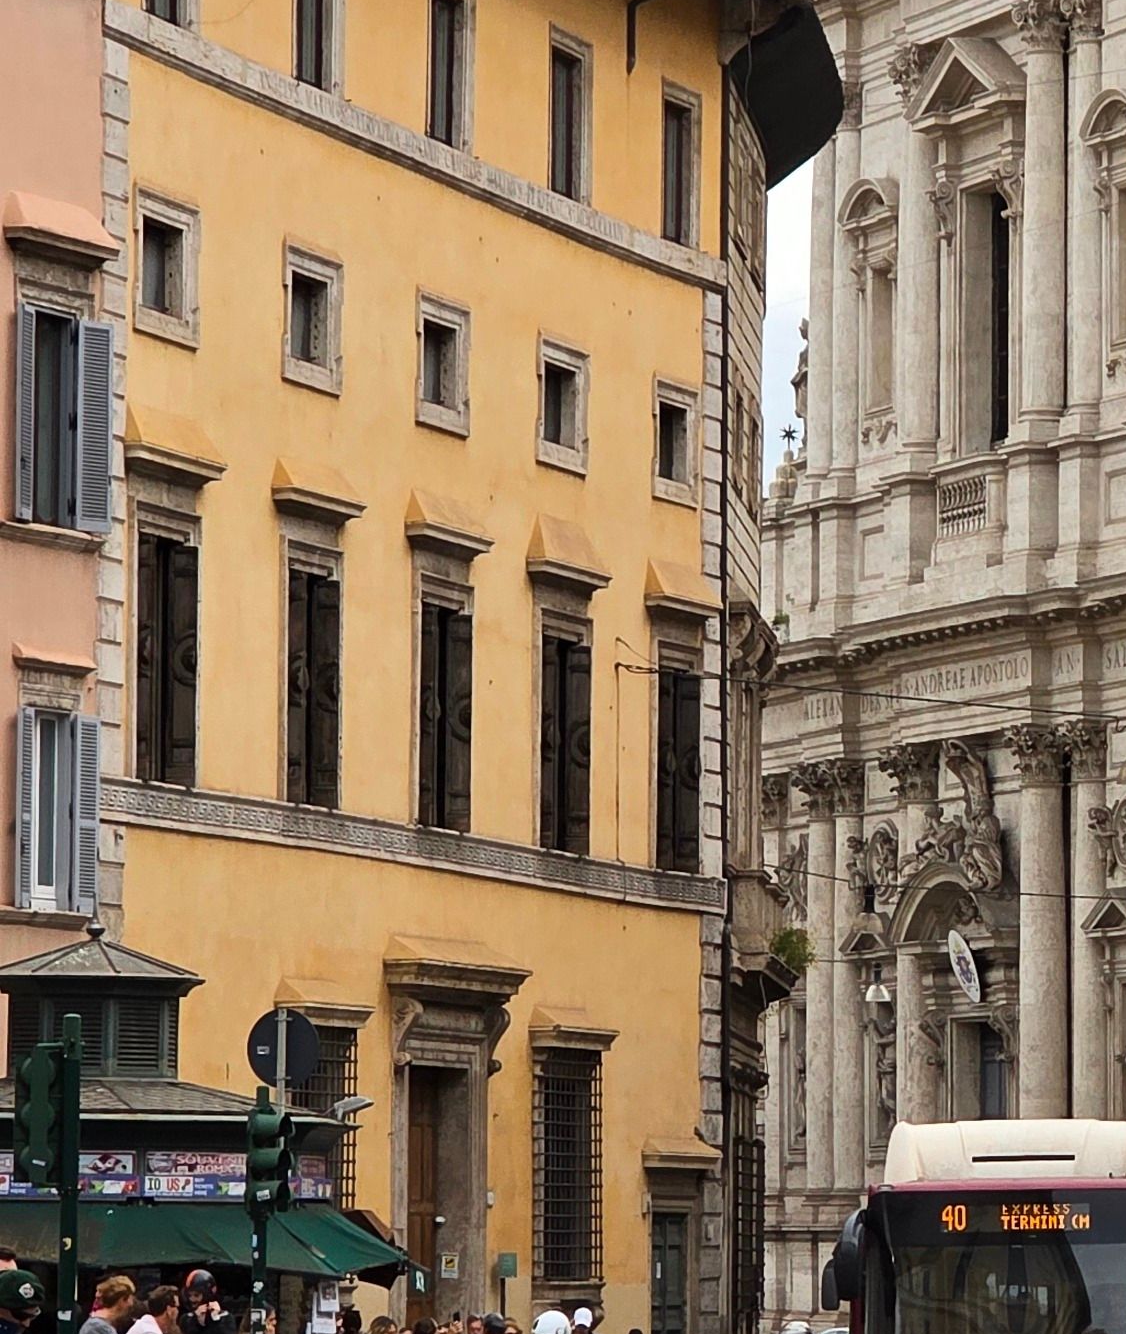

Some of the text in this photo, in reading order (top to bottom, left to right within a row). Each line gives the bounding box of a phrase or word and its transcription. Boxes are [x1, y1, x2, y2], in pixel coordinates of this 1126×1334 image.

[970, 657, 1029, 686] APOSTOLO
[941, 1204, 967, 1231] 40
[1002, 1203, 1071, 1215] EXPRESS
[1001, 1214, 1065, 1230] TERMINI
